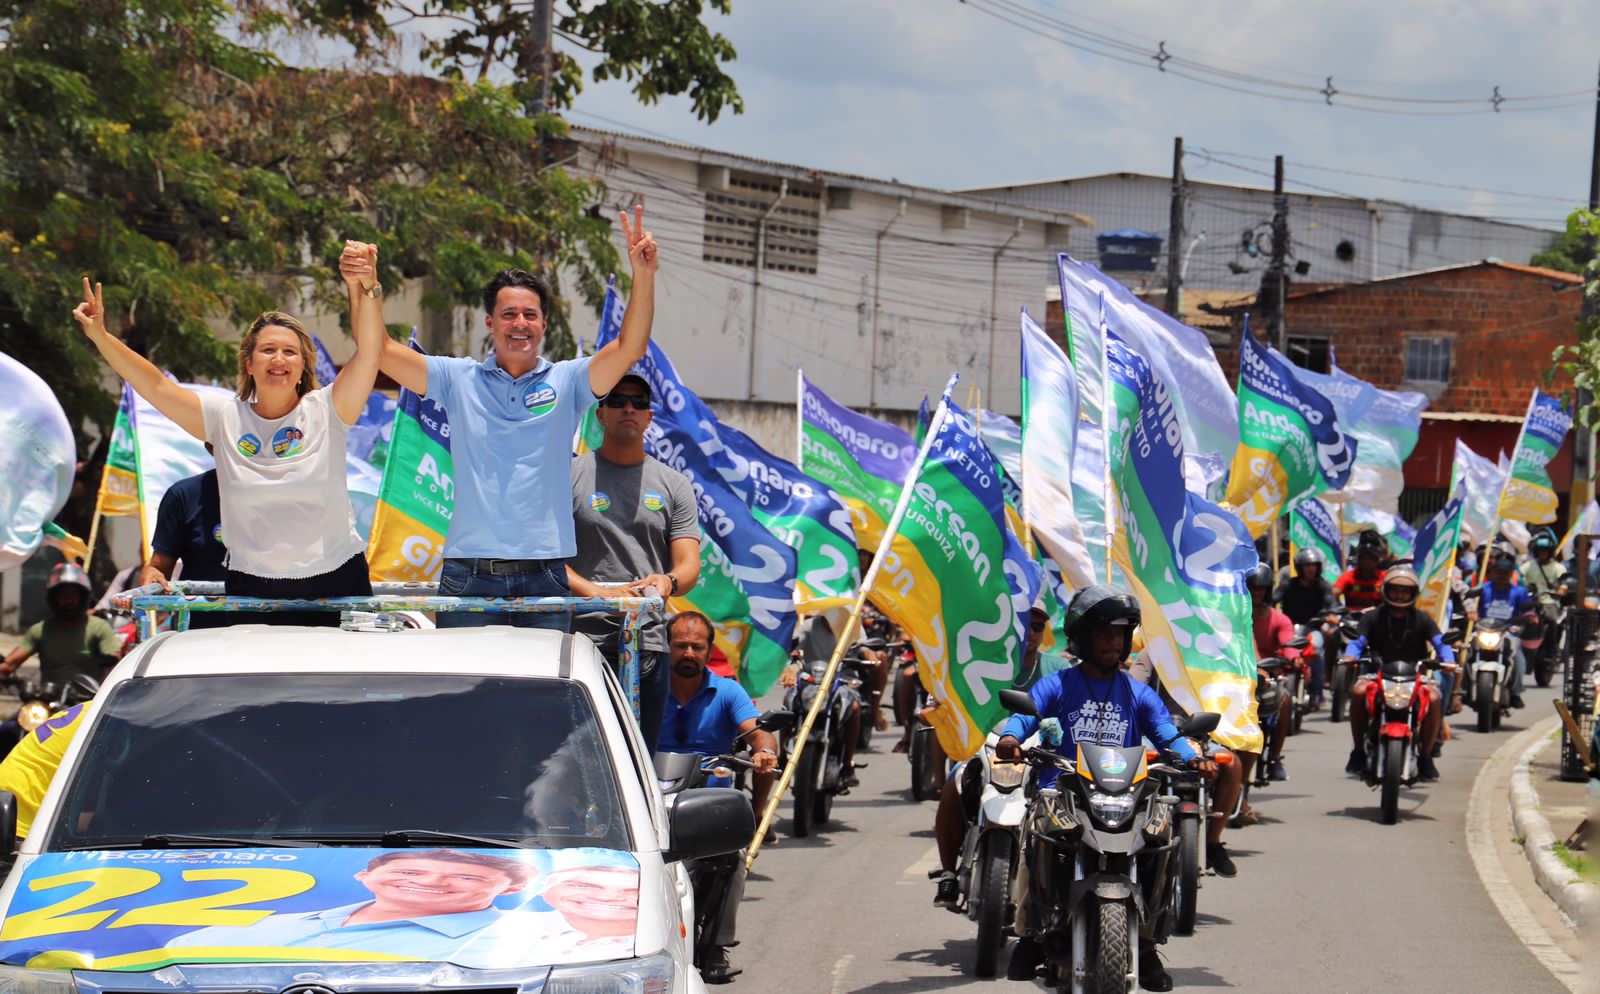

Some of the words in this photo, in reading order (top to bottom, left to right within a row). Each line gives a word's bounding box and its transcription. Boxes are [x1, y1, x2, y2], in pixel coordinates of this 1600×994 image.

[946, 446, 991, 489] NETTO
[906, 508, 956, 562] URQUIZA
[957, 592, 1017, 706] 22
[1073, 718, 1128, 734] ANDRÉ
[95, 850, 298, 863] Bolsonaro
[0, 867, 316, 941] 22
